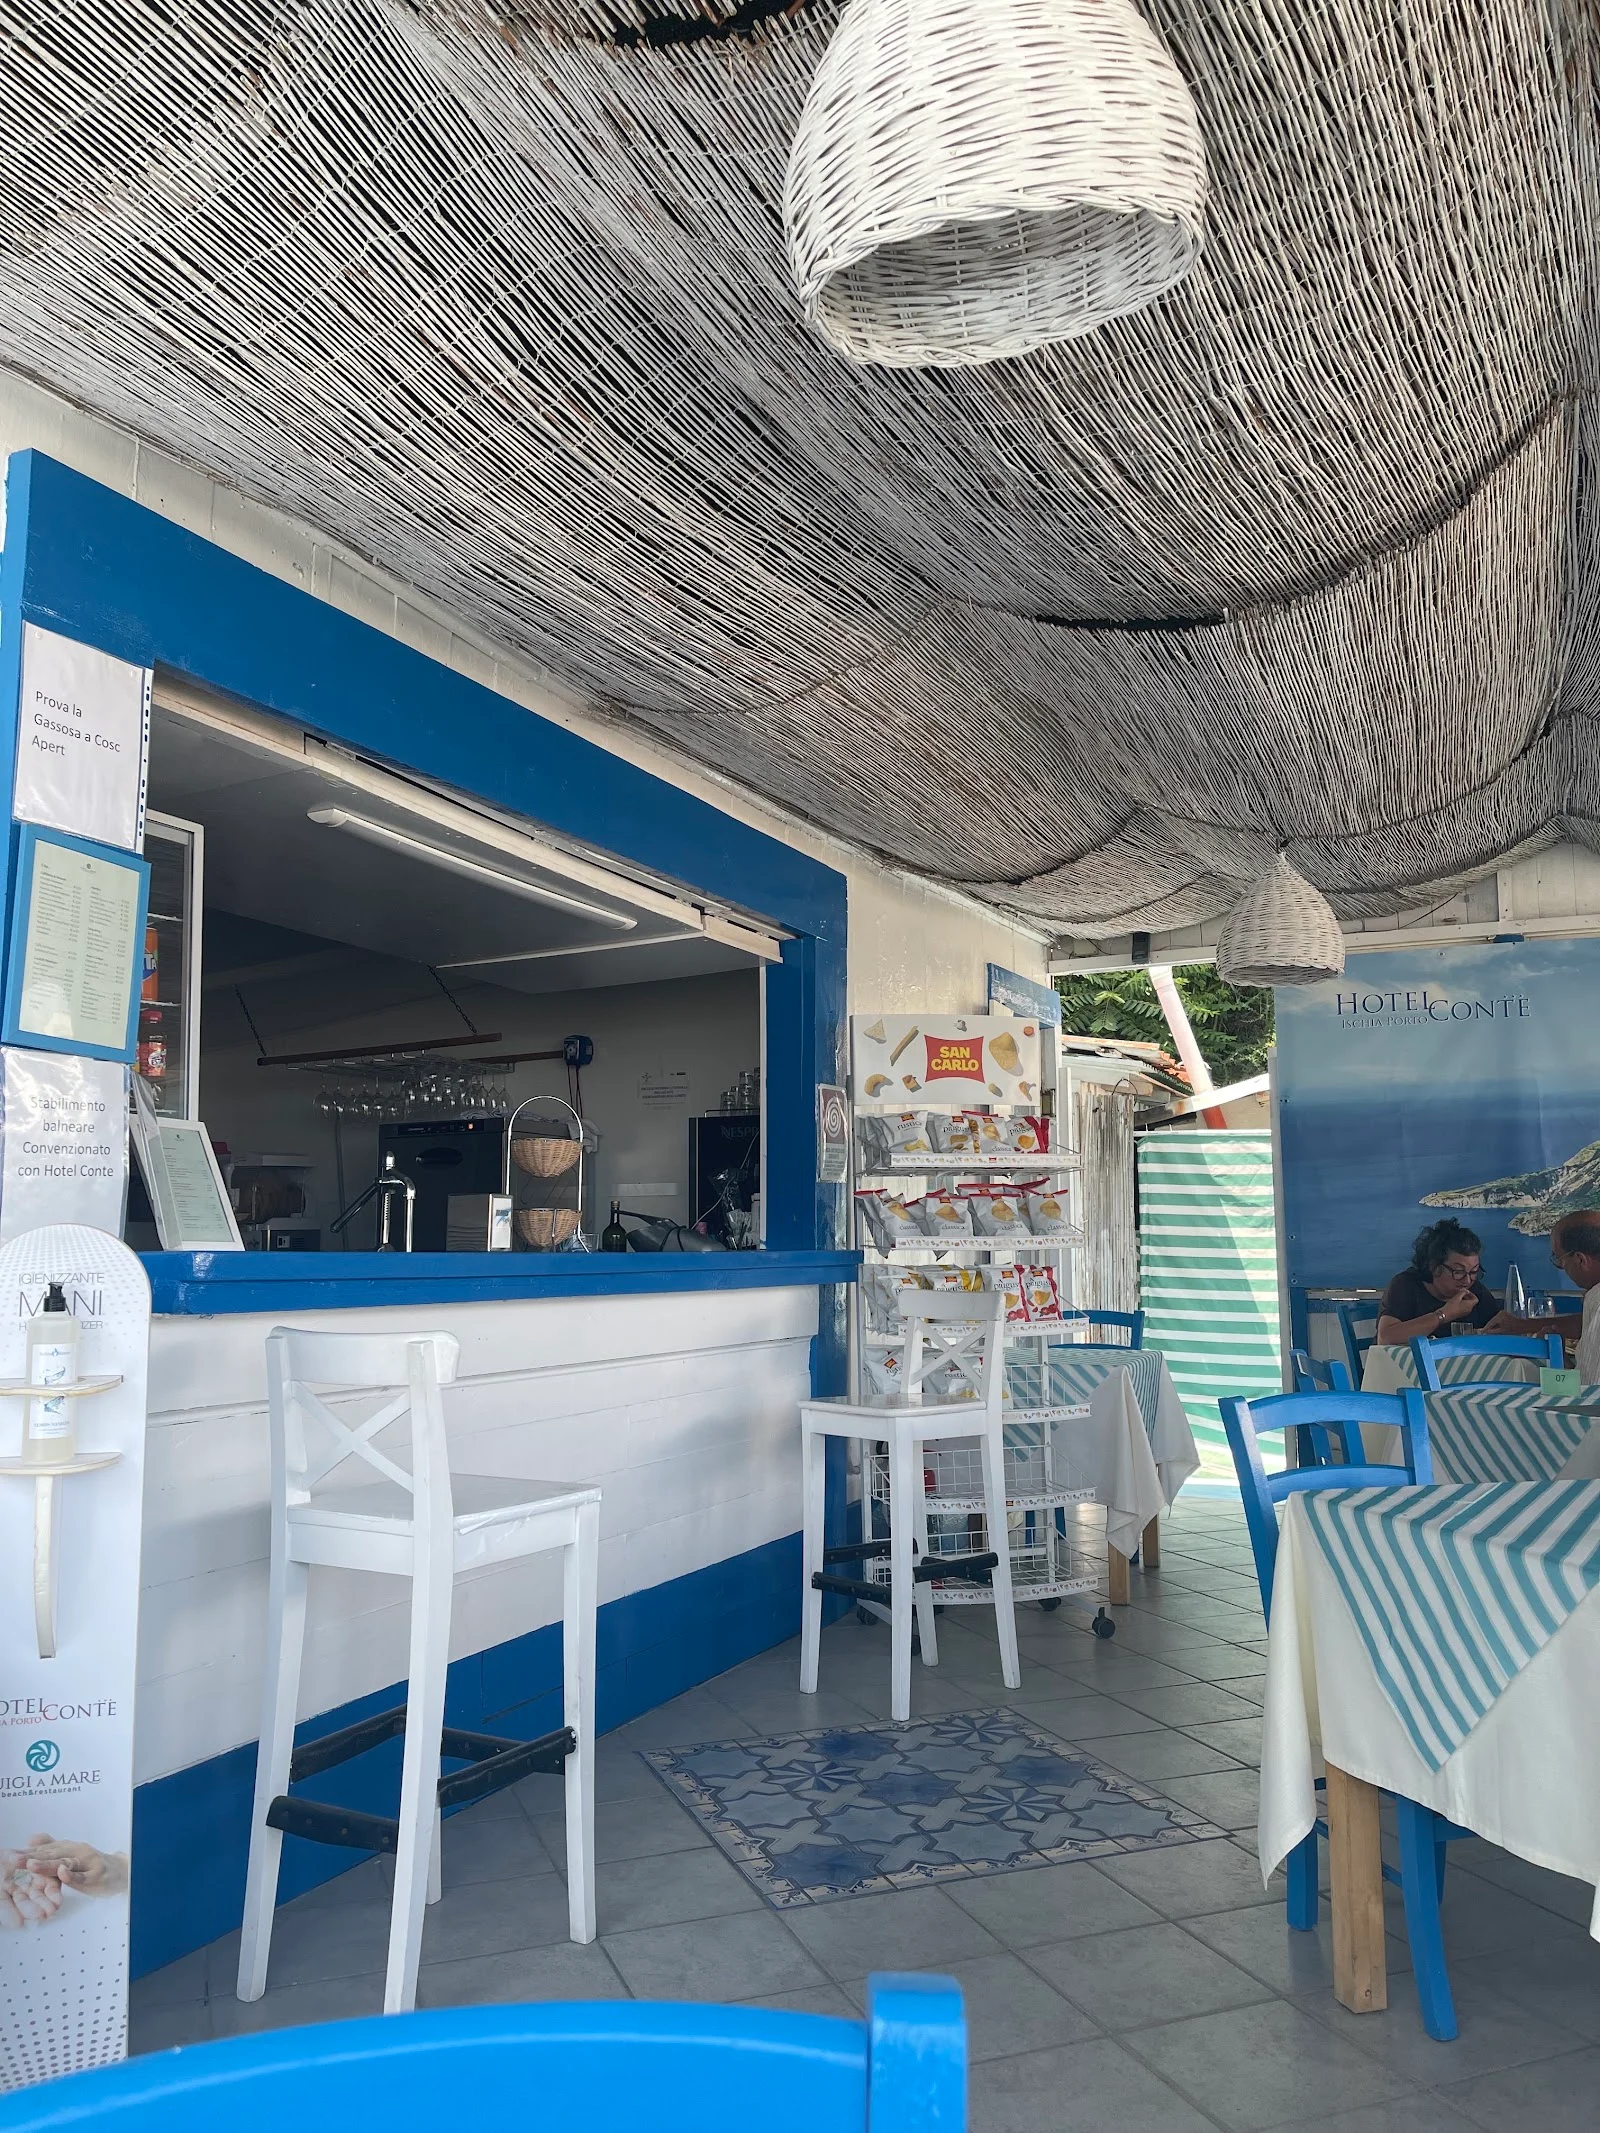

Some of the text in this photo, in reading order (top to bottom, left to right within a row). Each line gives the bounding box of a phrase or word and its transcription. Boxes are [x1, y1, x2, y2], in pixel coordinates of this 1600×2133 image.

[35, 691, 82, 718] Prova la
[34, 713, 121, 753] Gassosa a Cosc
[31, 735, 66, 756] Apert
[1335, 991, 1531, 1022] HOTEL CONTE
[1342, 1015, 1429, 1030] ISCHIA PORTO
[939, 1046, 971, 1059] SAN
[930, 1058, 980, 1072] CARLO
[30, 1096, 106, 1112] Stabilimento
[43, 1119, 95, 1133] balneare
[22, 1141, 111, 1156] Convenzionato
[18, 1164, 114, 1177] con Hotel Conte
[18, 1272, 105, 1285] IGIENIZZANTE
[18, 1289, 103, 1318] MNI
[944, 1371, 968, 1379] rustic
[1555, 1374, 1566, 1383] 07
[0, 1697, 117, 1722] OTEL CONTE
[10, 1715, 42, 1727] PORTO
[50, 1769, 102, 1787] MARE
[1, 1785, 82, 1798] beach&restaurant
